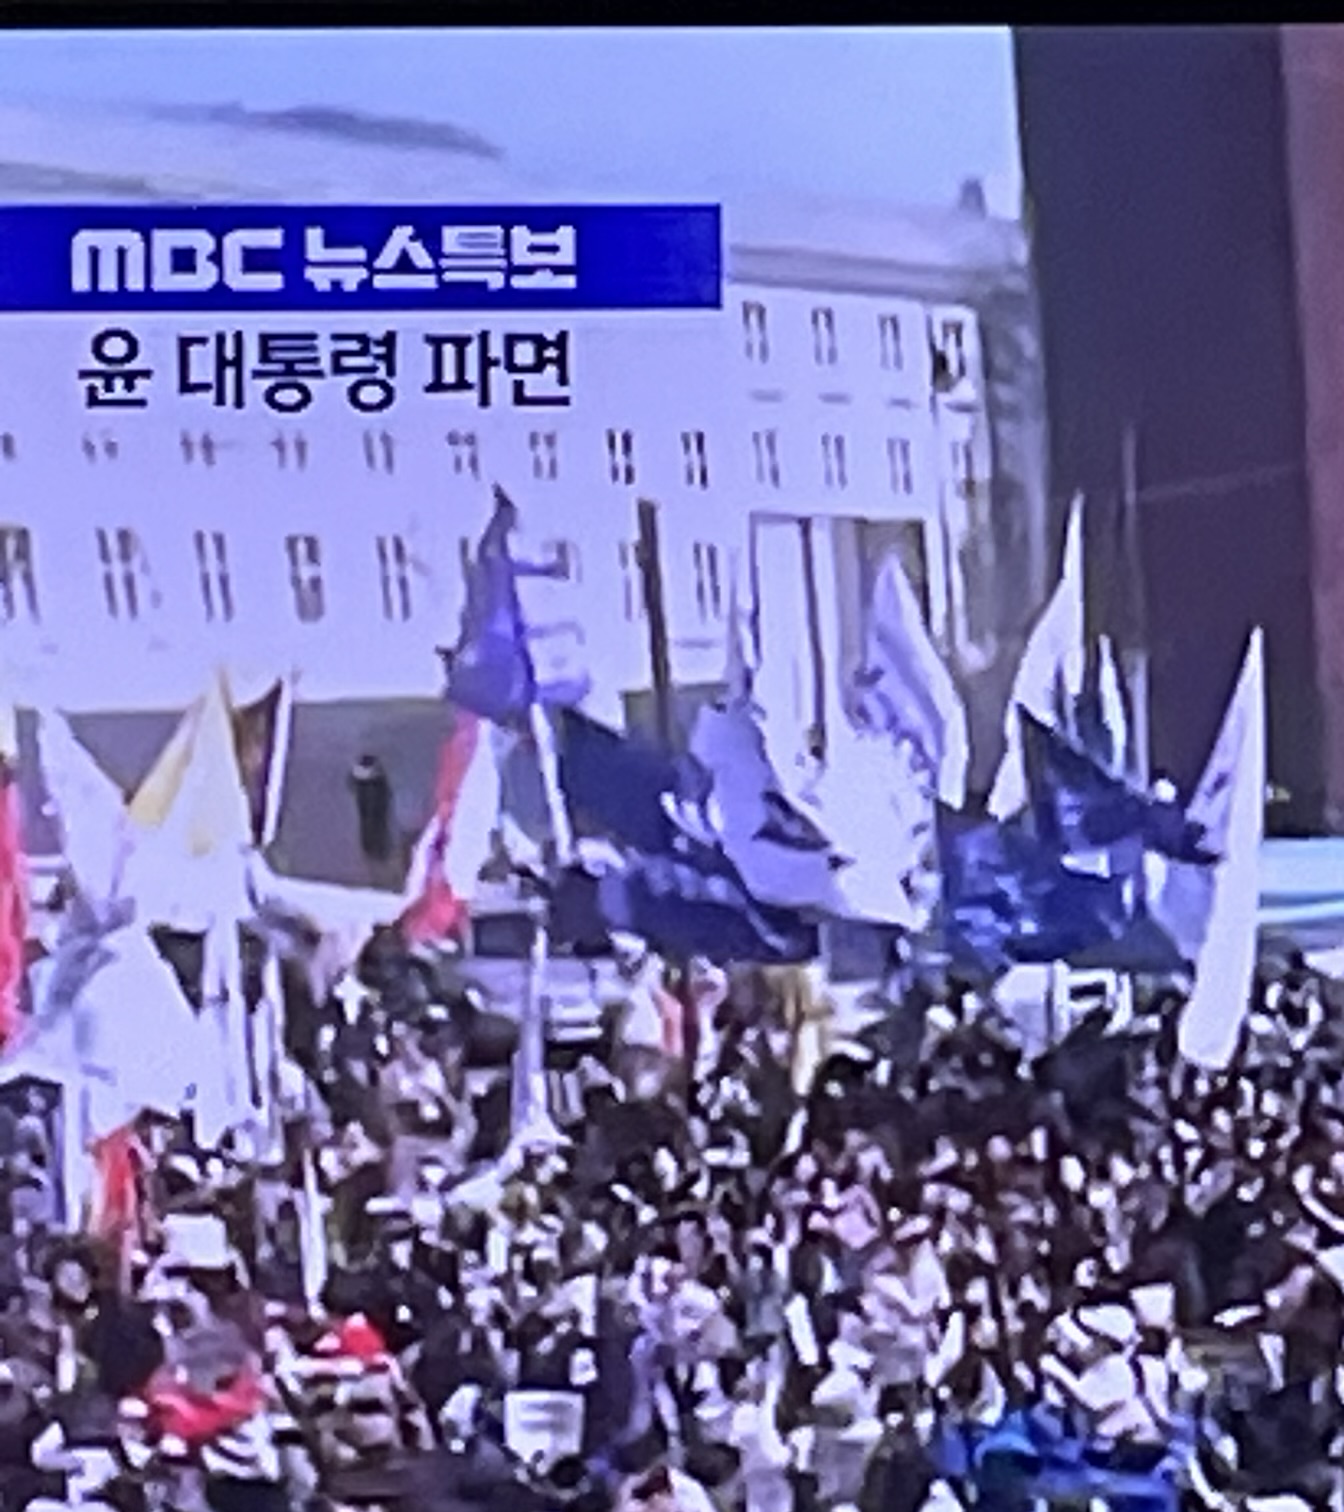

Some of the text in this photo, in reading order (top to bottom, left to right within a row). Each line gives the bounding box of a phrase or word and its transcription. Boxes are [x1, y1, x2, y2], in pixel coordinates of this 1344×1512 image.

[71, 225, 577, 292] MBC 뉴스특보
[77, 328, 572, 412] 윤 대통령 파면
